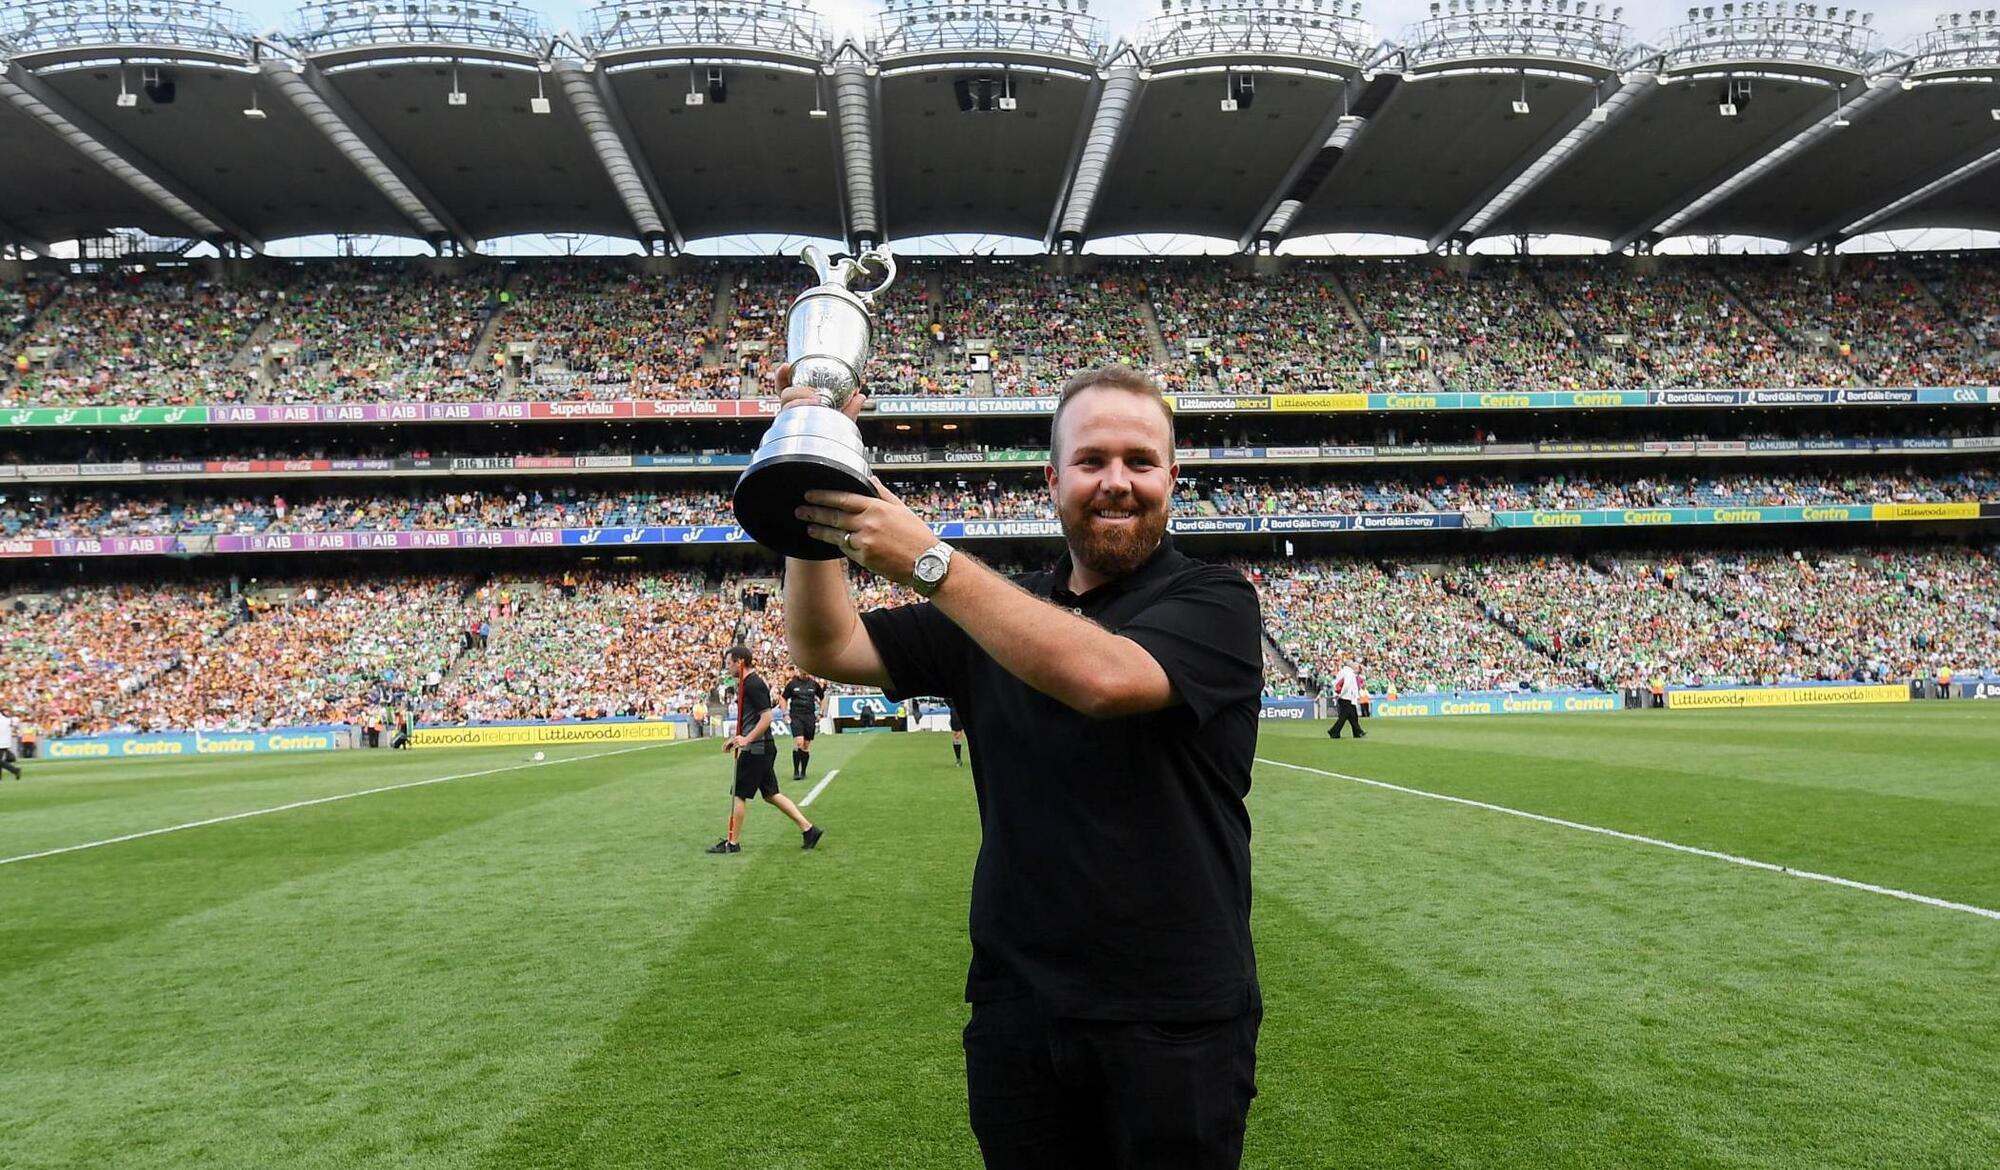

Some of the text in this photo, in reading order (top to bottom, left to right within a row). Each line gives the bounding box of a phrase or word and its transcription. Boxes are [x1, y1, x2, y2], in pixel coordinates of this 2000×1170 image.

[1386, 395, 1436, 408] Centra
[1480, 394, 1530, 407] Centra
[1573, 393, 1622, 407] Centra
[1667, 393, 1687, 403] Bord
[1706, 393, 1734, 405] Energy
[1758, 392, 1777, 402] Bord
[1796, 391, 1824, 404] Energy
[1847, 391, 1866, 400] Bord
[1884, 390, 1912, 402] Energy
[445, 405, 470, 418] AIB
[498, 405, 522, 417] AIB
[550, 402, 614, 417] SuperValu
[654, 401, 717, 415] SuperValu
[880, 400, 907, 412] GAA
[908, 399, 966, 412] MUSEUM
[967, 399, 978, 411] &
[979, 398, 1038, 411] STADIUM
[230, 408, 256, 420] AIB
[284, 407, 309, 420] AIB
[338, 406, 364, 419] AIB
[391, 406, 416, 418] AIB
[457, 459, 477, 469] BIG
[482, 458, 513, 468] TREE
[884, 454, 922, 462] GUINNESS
[945, 453, 984, 462] GUINNESS
[1532, 511, 1581, 525] Centra
[1624, 510, 1673, 523] Centra
[1713, 508, 1761, 522] Centra
[1802, 507, 1849, 520] Centra
[1176, 520, 1194, 531] Bord
[1216, 519, 1246, 532] Energy
[1271, 519, 1290, 530] Bord
[1311, 518, 1341, 531] Energy
[1365, 517, 1384, 528] Bord
[1405, 516, 1434, 528] Energy
[965, 523, 1062, 538] GAA MUSEUM
[266, 537, 291, 549] AIB
[320, 536, 344, 548] AIB
[373, 534, 397, 547] AIB
[425, 533, 450, 545] AIB
[478, 532, 503, 544] AIB
[529, 531, 554, 544] AIB
[76, 540, 101, 552] AIB
[130, 539, 154, 552] AIB
[1792, 687, 1864, 702] Littlewoods
[1377, 703, 1428, 716] Centra
[1440, 701, 1490, 714] Centra
[1502, 698, 1552, 712] Centra
[1564, 696, 1614, 710] Centra
[1267, 707, 1305, 720] Energy
[482, 730, 530, 743] Ireland
[538, 726, 622, 741] Littlewoods
[622, 724, 670, 738] Ireland
[50, 742, 109, 756] Centra
[123, 740, 182, 754] Centra
[197, 738, 255, 754] Centra
[269, 735, 327, 750] Centra
